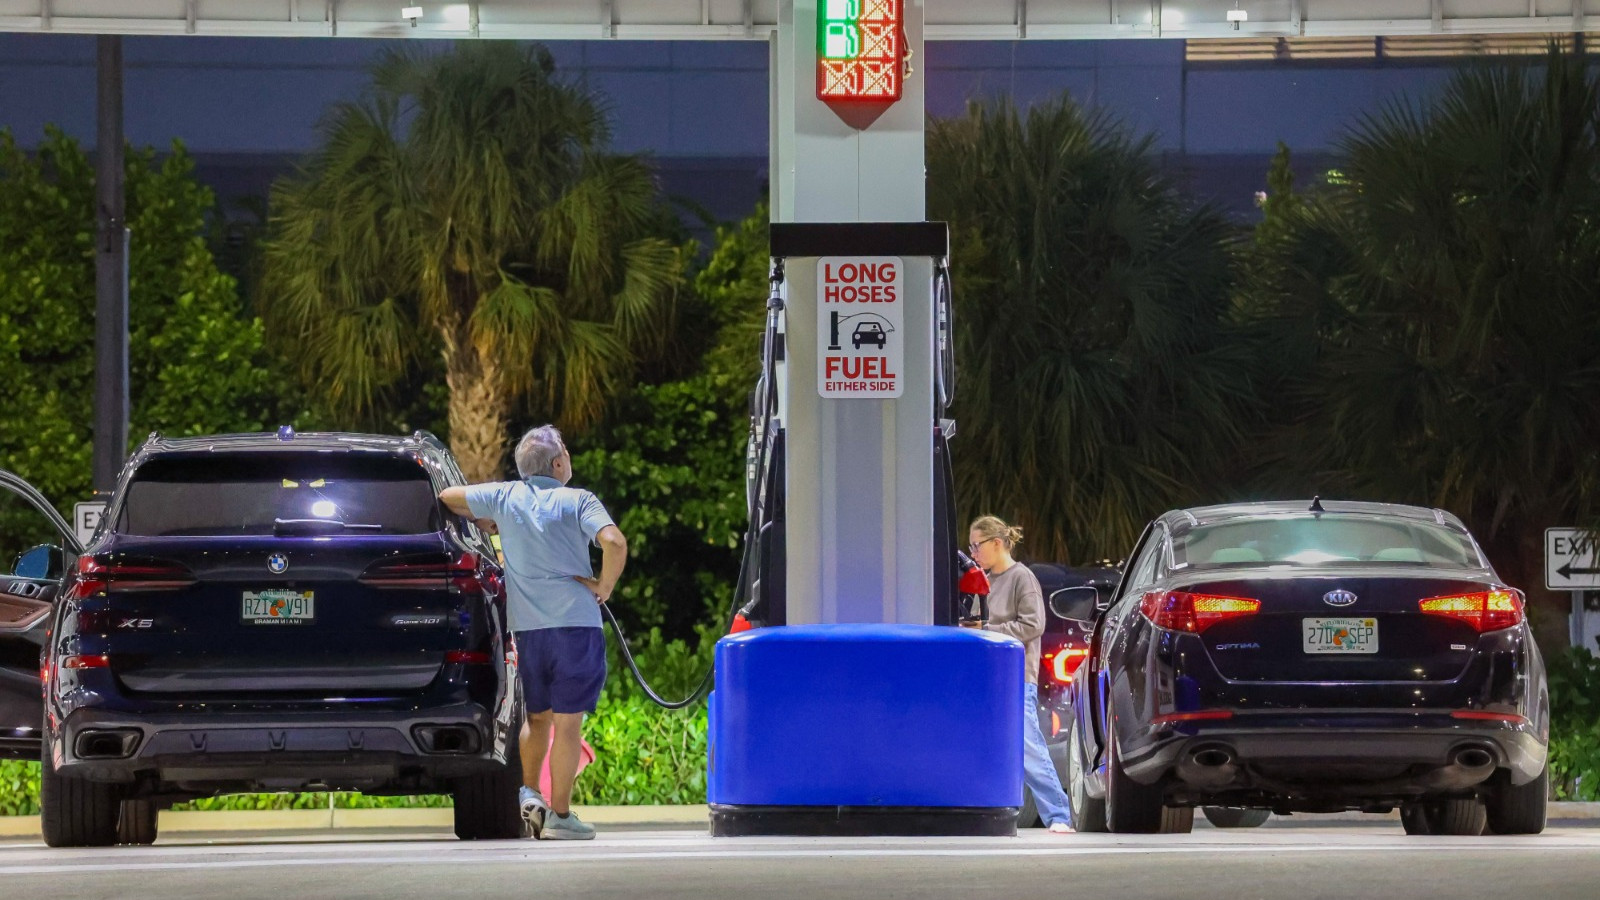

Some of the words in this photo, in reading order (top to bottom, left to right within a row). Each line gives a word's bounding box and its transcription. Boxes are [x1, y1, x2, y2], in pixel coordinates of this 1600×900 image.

[824, 263, 896, 283] LONG
[824, 285, 896, 303] HOSES
[825, 356, 896, 379] FUEL
[825, 381, 867, 391] EITHER
[869, 381, 895, 391] SIDE
[286, 598, 308, 615] V91
[1329, 593, 1352, 603] KIA
[117, 618, 154, 628] X5
[1349, 627, 1374, 644] SEP
